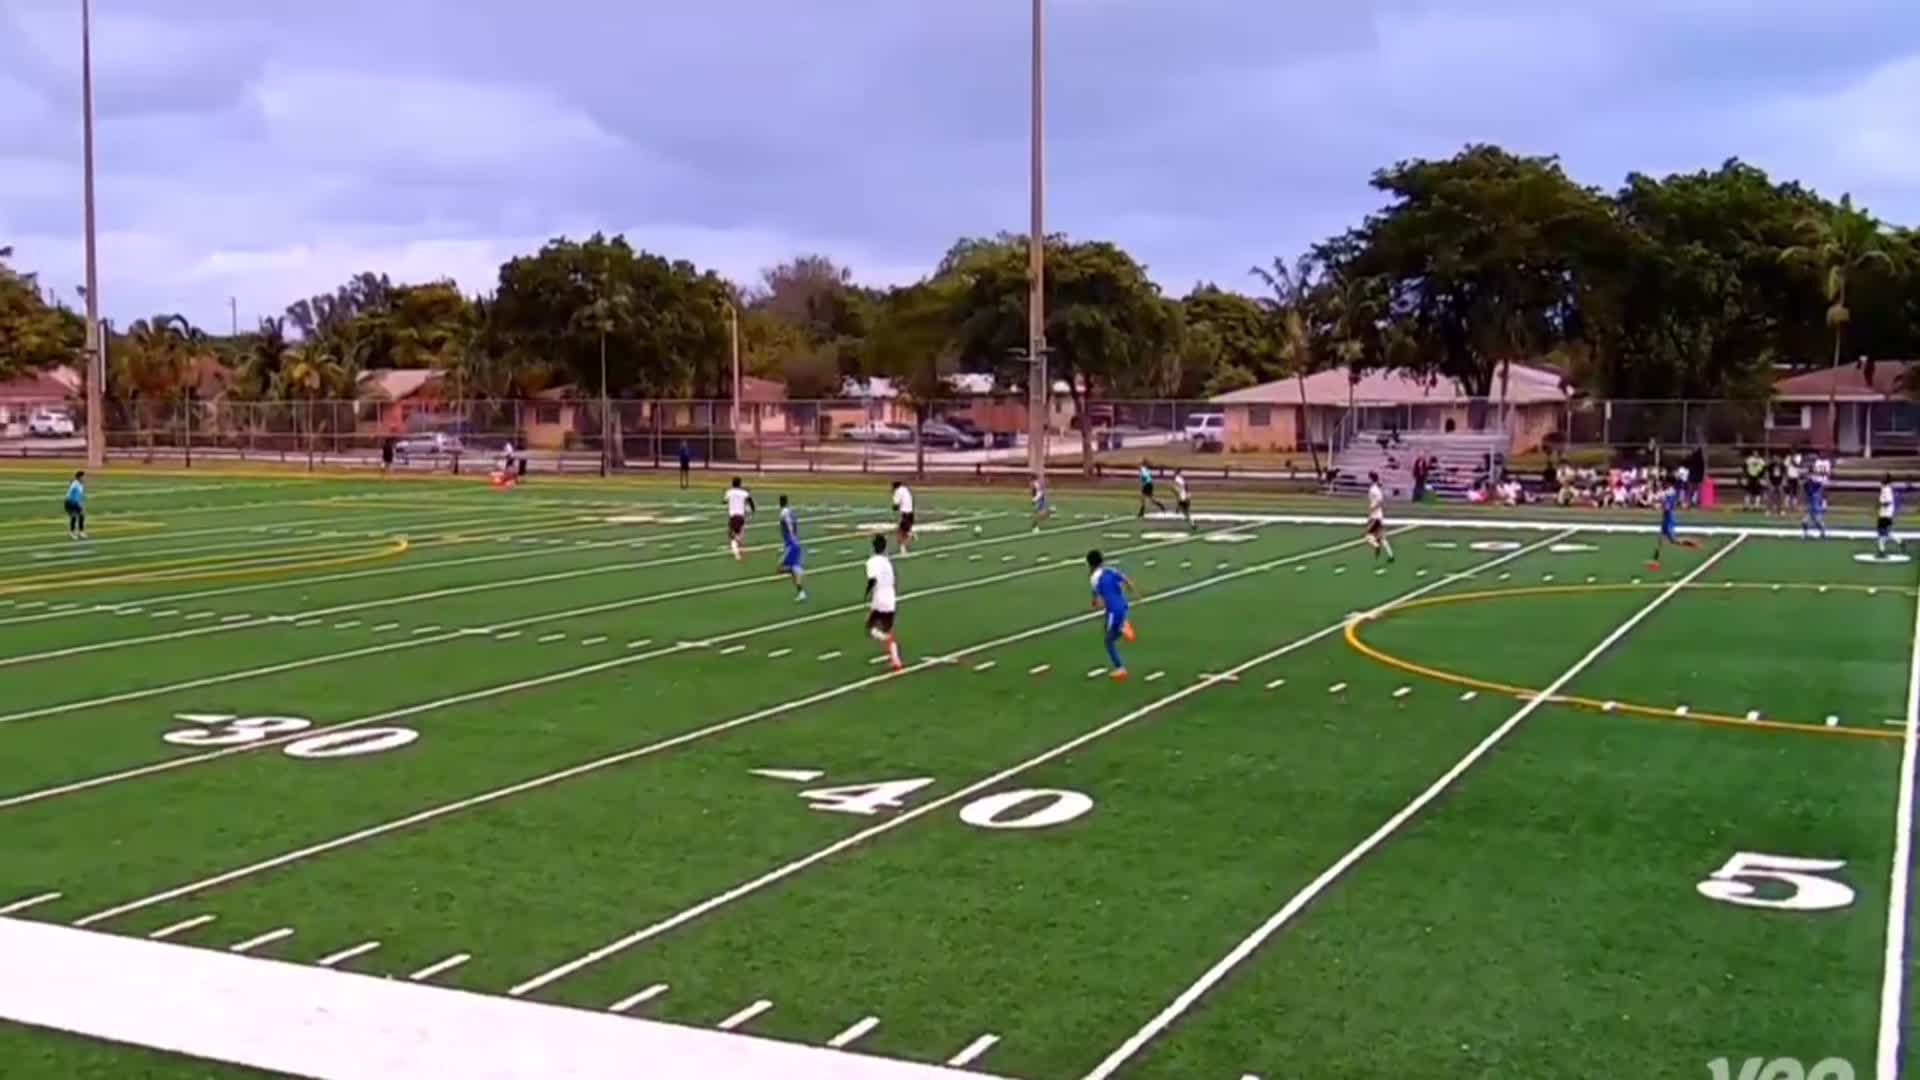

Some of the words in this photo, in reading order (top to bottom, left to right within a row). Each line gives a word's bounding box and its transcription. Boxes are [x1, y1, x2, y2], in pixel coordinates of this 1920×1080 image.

[163, 716, 419, 757] 30
[798, 777, 1094, 828] 40
[1697, 852, 1855, 910] 5
